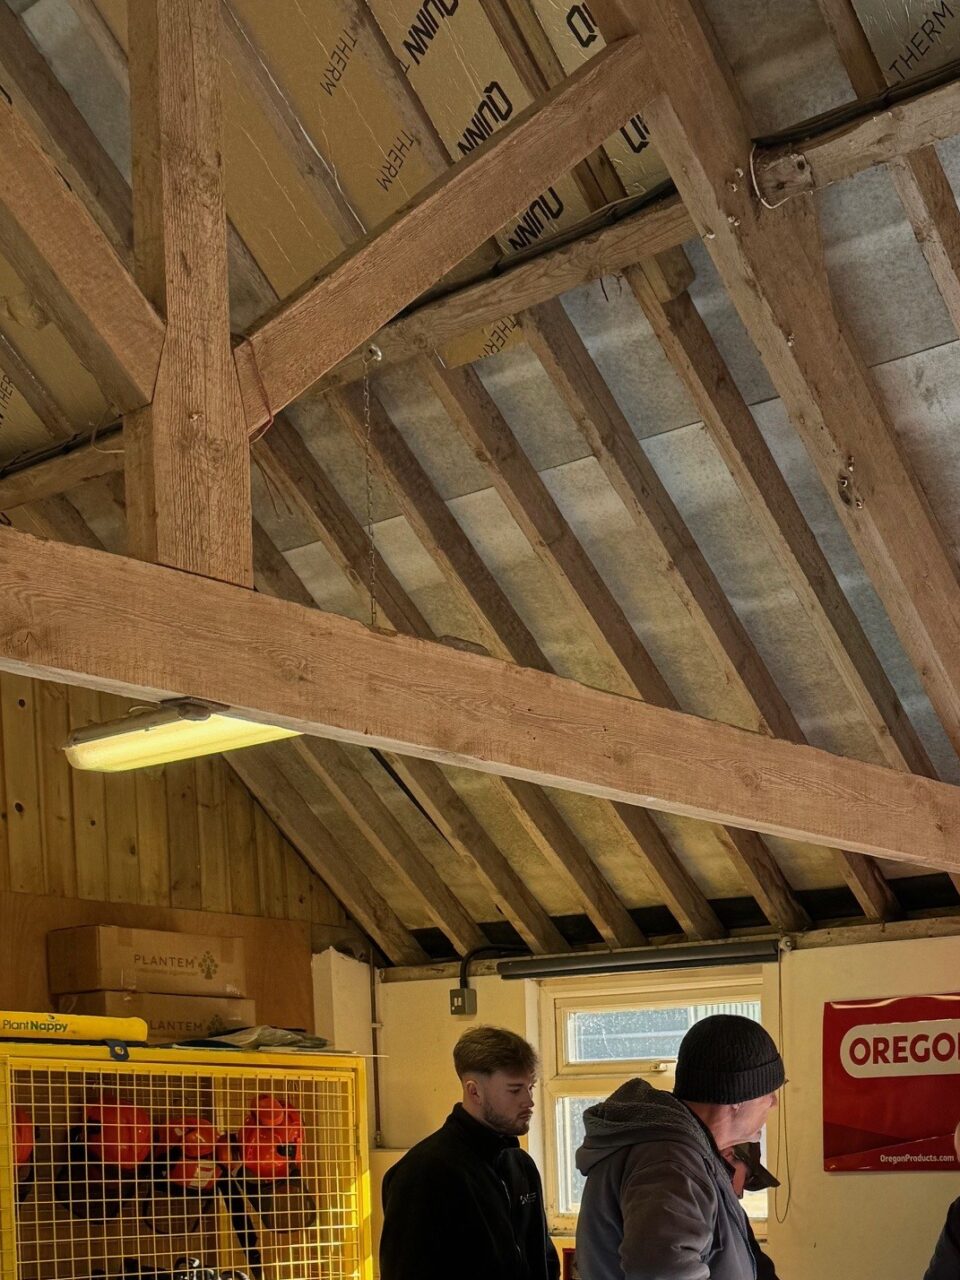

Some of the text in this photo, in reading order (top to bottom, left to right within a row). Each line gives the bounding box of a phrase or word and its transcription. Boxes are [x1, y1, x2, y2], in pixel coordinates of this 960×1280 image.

[888, 0, 955, 80] THERM
[319, 29, 358, 97] THERM
[375, 130, 415, 193] THERM
[133, 953, 195, 969] PLANTEM
[150, 1021, 203, 1032] LANTEM
[879, 1153, 955, 1165] OregonProducts.com
